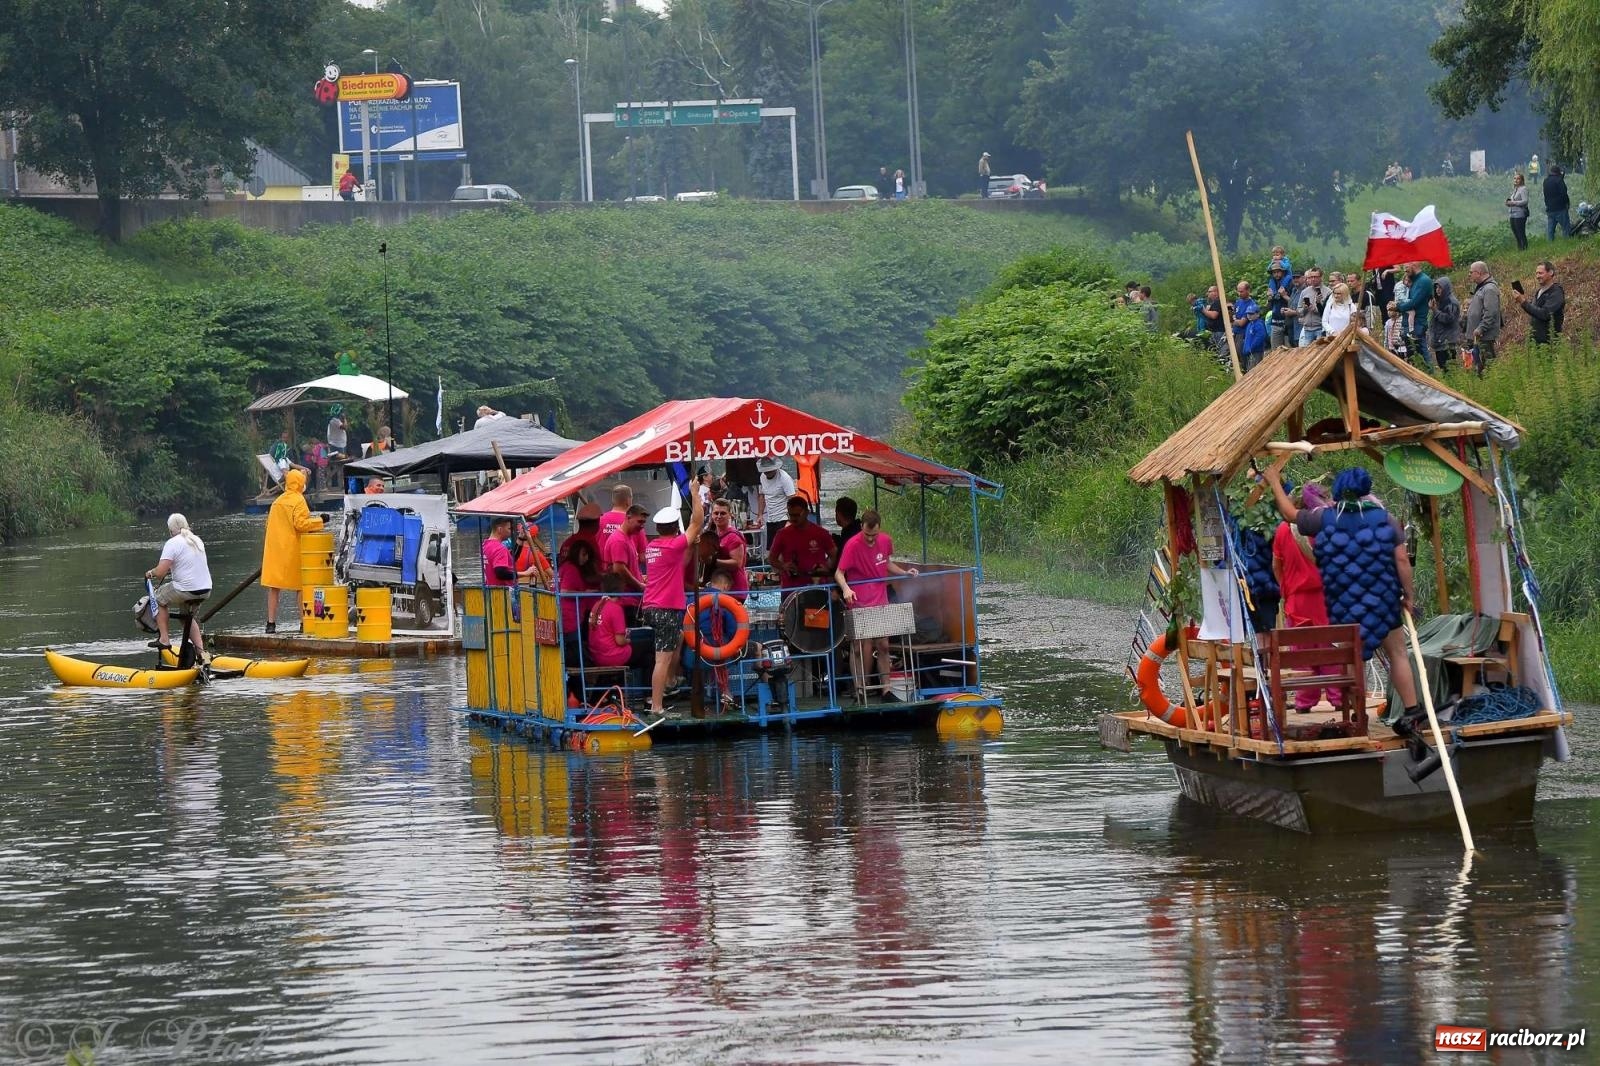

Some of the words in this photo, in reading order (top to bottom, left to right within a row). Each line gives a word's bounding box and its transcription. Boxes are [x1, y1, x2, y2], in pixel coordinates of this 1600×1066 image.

[341, 79, 394, 90] Biedronka
[665, 432, 855, 463] BŁAŻEJOWICE
[95, 671, 129, 683] POLA-ONE
